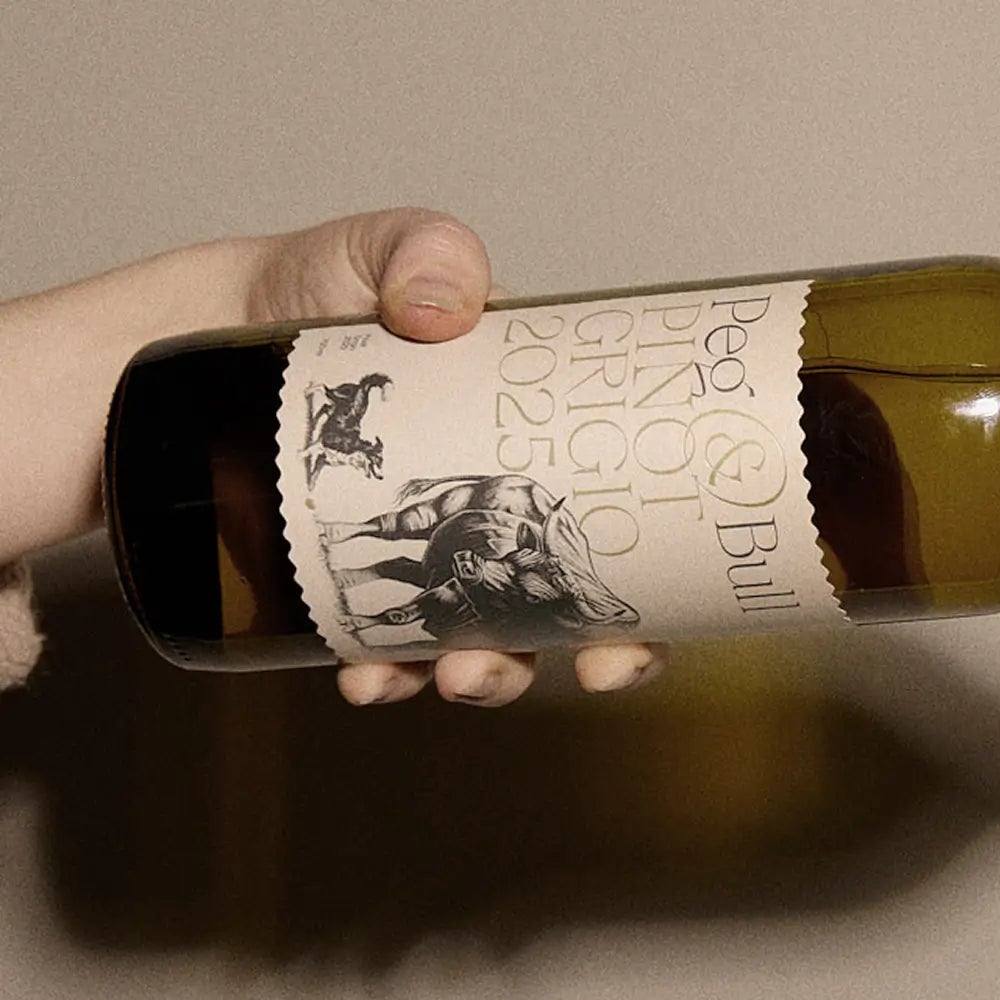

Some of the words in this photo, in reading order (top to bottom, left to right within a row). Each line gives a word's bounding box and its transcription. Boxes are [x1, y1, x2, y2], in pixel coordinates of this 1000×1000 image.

[496, 315, 565, 472] 2025
[633, 304, 703, 521] PINOT
[691, 295, 771, 397] Peg
[564, 309, 639, 556] GRIGIO
[715, 514, 800, 613] Bull
